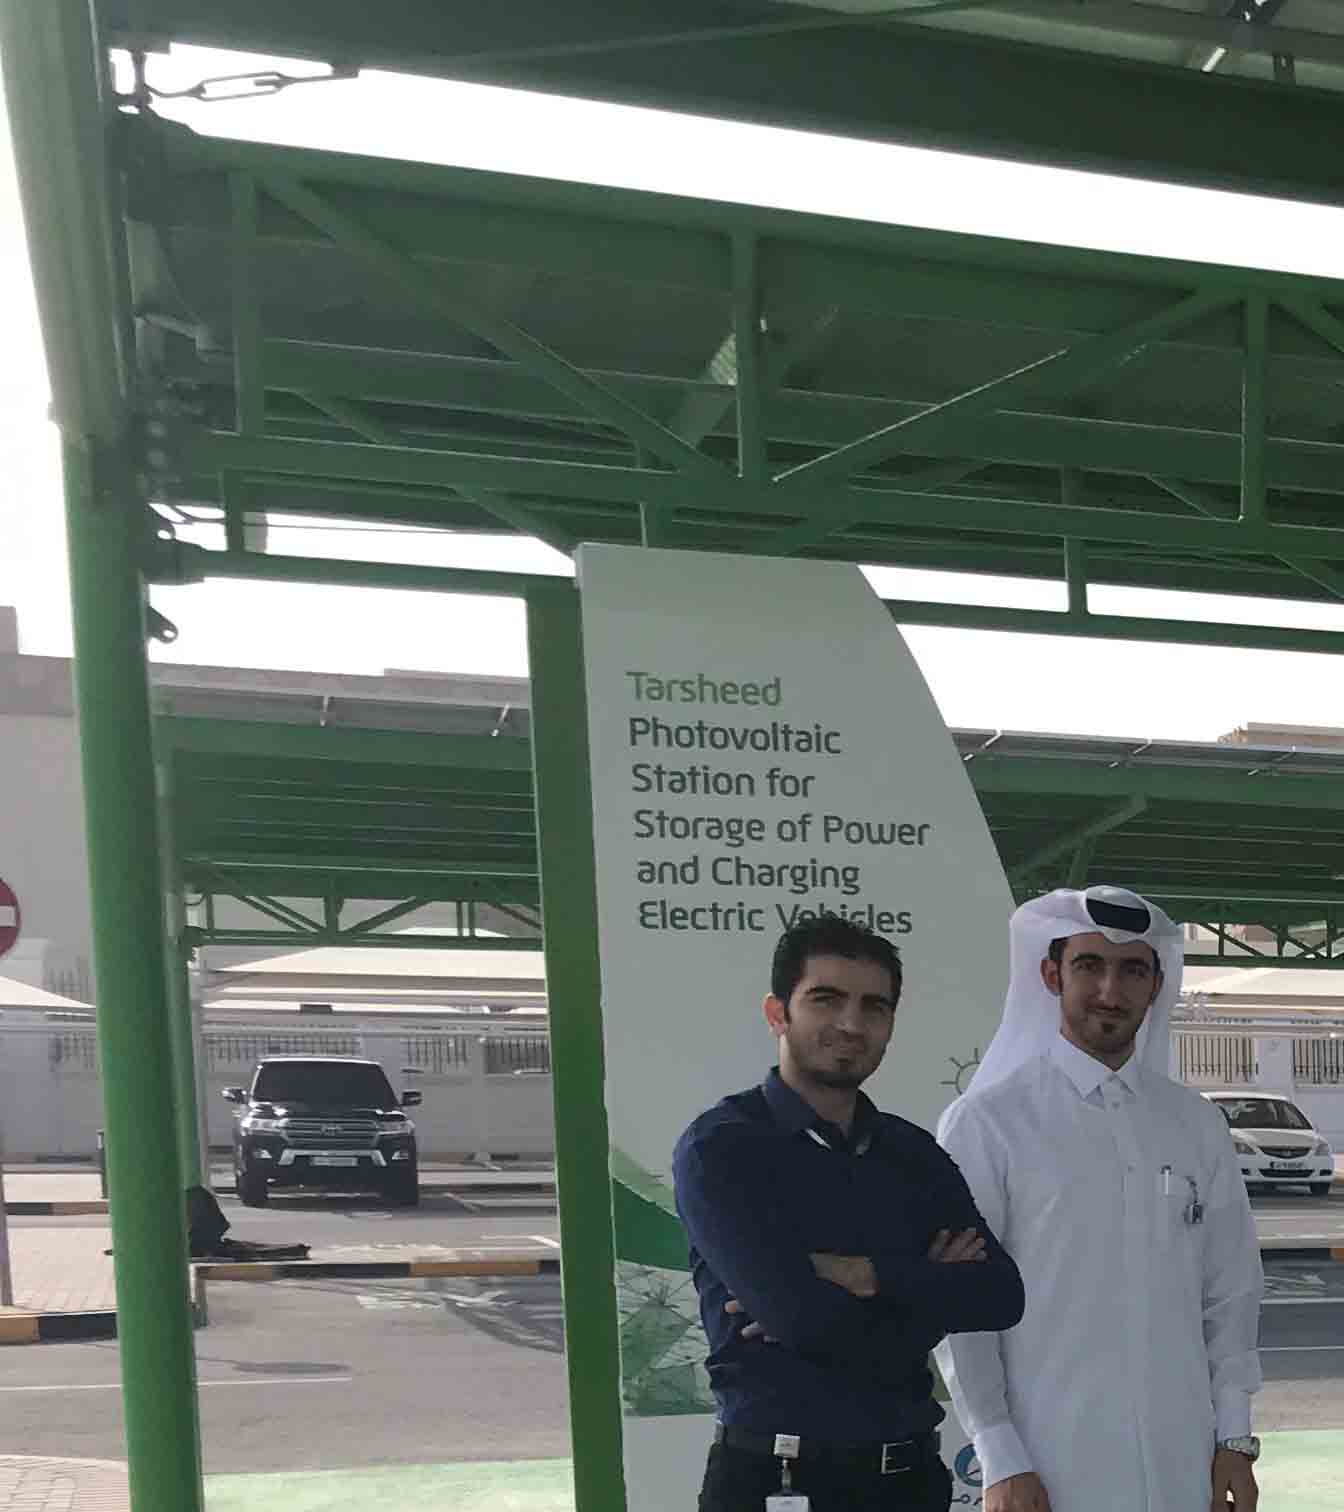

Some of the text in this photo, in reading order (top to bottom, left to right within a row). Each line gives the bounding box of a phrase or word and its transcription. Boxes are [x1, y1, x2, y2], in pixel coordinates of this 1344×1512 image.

[626, 671, 783, 707] Tarsheed
[629, 716, 842, 755] Photovoltaic
[632, 763, 817, 798] Station for
[633, 809, 931, 847] Storage of Power
[637, 855, 861, 895] and Charging
[639, 899, 765, 931] Electric
